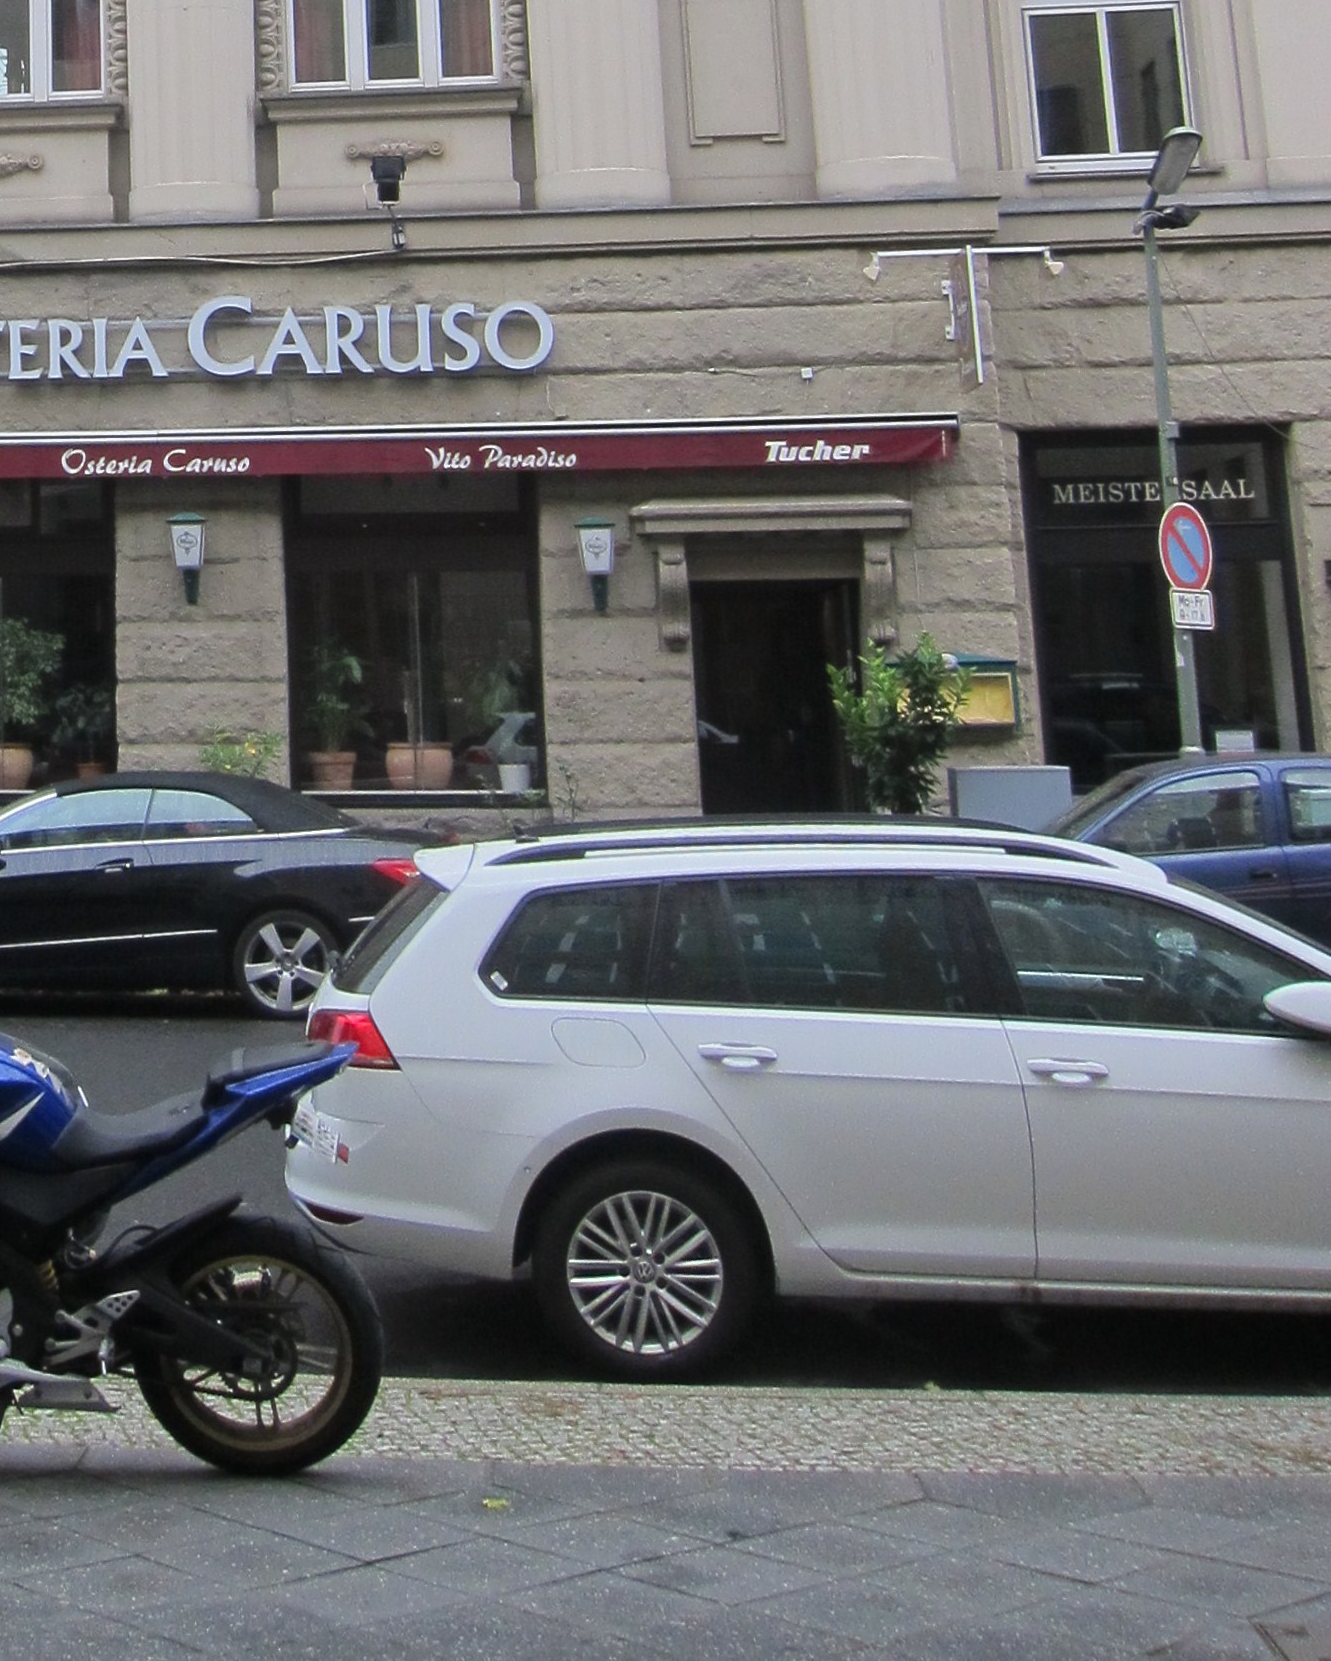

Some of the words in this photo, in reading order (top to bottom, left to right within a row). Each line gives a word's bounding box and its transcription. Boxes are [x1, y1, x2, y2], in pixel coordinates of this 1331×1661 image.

[187, 294, 555, 378] CARUSO
[60, 448, 153, 475] Osteria
[162, 448, 250, 473] Caruso
[424, 446, 472, 470] Vito
[478, 444, 577, 469] Paradiso
[764, 439, 870, 463] Tucher
[1053, 479, 1255, 504] MEISTESAAL
